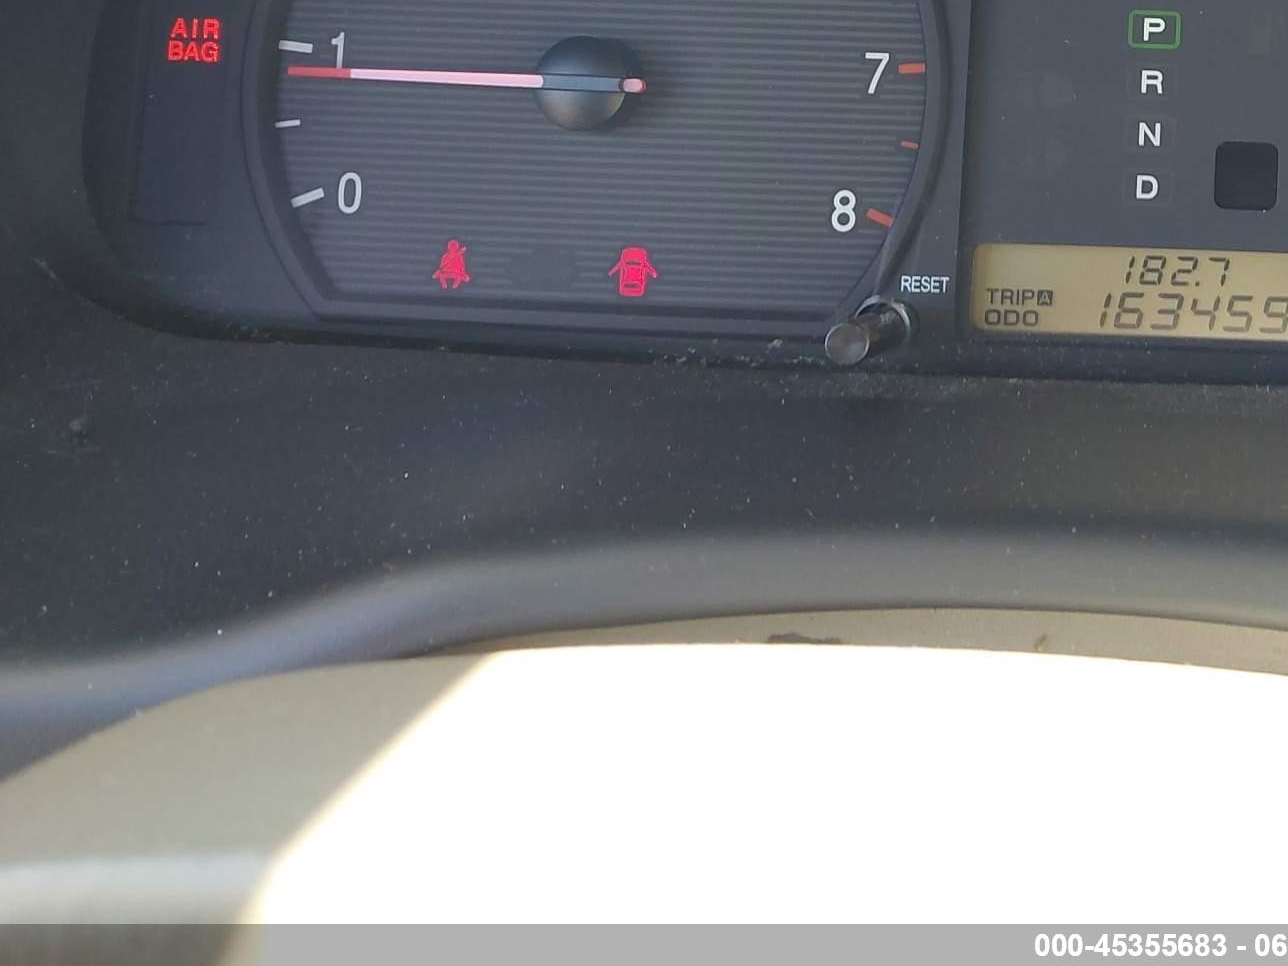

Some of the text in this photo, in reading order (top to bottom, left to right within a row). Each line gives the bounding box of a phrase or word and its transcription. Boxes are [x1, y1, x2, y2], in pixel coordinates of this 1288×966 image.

[170, 18, 221, 38] AIR
[1143, 18, 1166, 41] P
[167, 41, 219, 62] BAG
[329, 31, 346, 69] 1
[864, 52, 890, 95] 7
[1141, 71, 1163, 94] R
[1139, 124, 1161, 146] N
[337, 173, 362, 214] 0
[1136, 176, 1159, 199] D
[831, 190, 857, 232] 8
[1123, 256, 1230, 287] 182.7
[900, 276, 949, 294] RESET
[984, 310, 1039, 327] ODO
